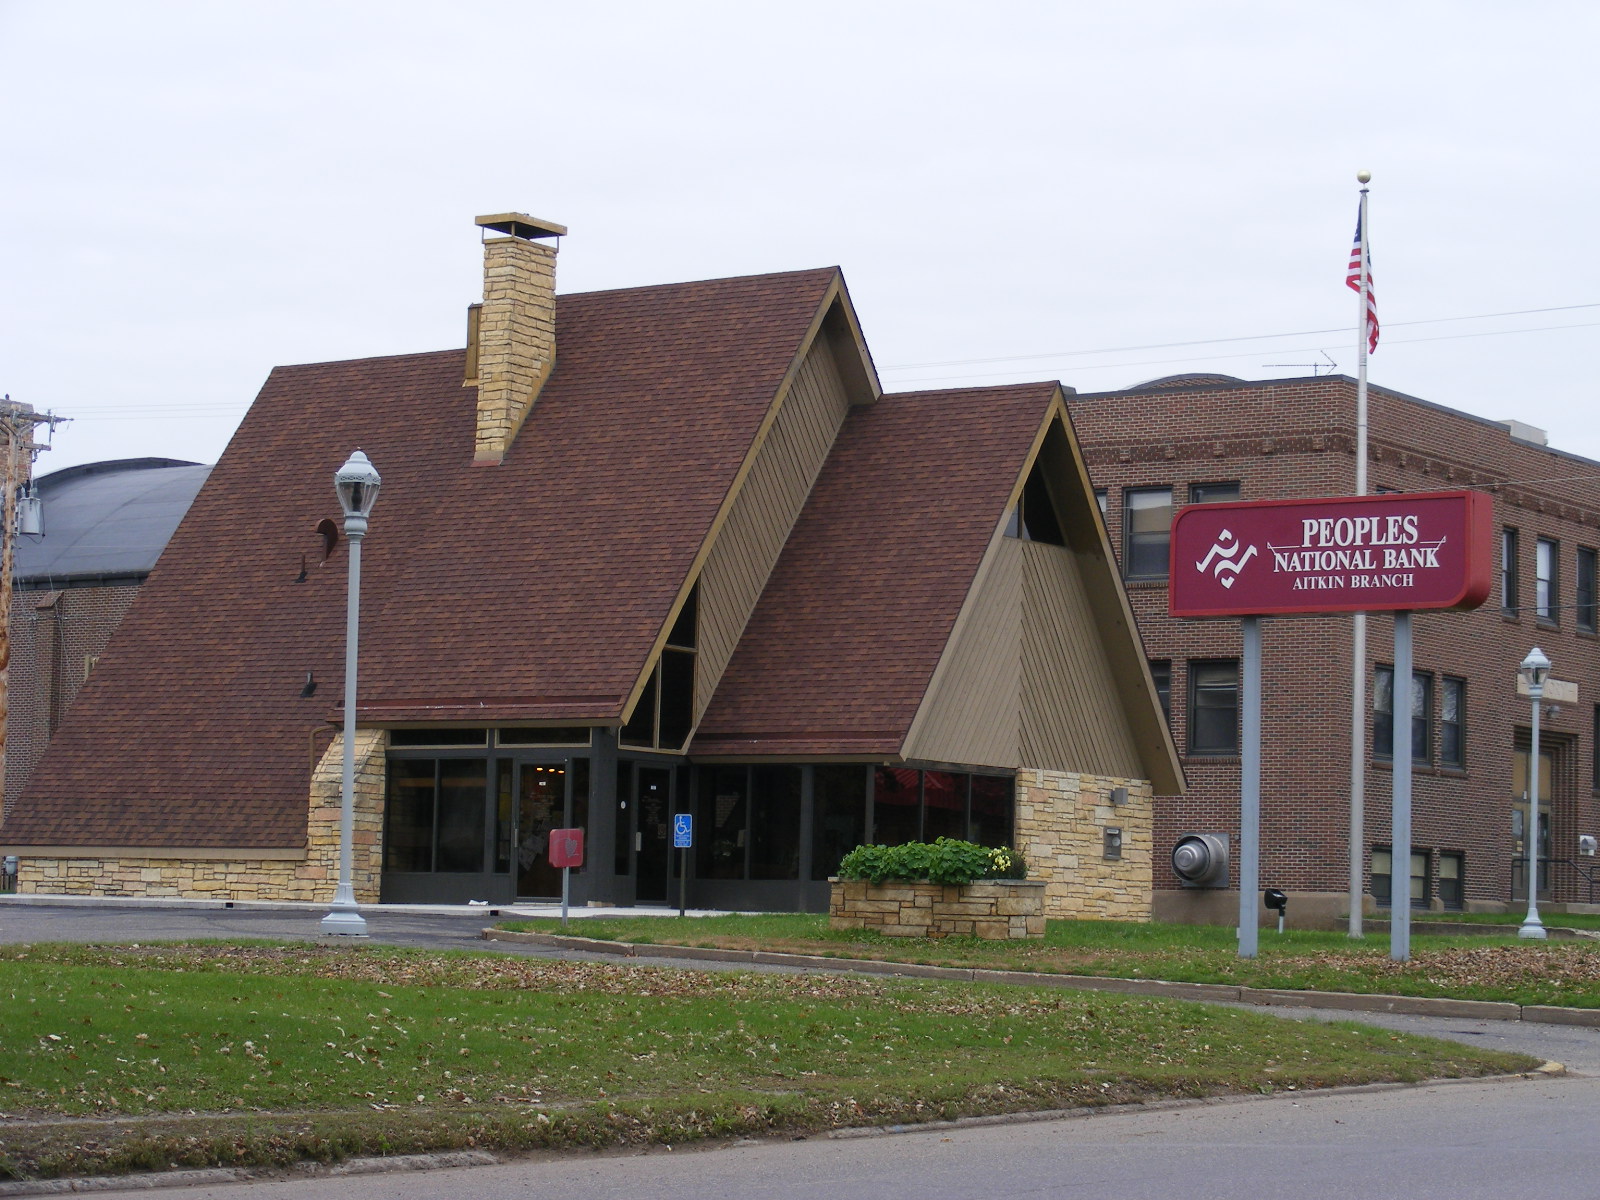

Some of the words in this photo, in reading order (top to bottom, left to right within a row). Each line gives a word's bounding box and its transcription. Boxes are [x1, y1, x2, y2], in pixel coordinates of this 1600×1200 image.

[1301, 515, 1418, 548] PEOPLES
[1273, 550, 1376, 573] NATIONAL
[1382, 547, 1440, 569] BANK
[1292, 575, 1345, 590] AITKIN
[1351, 573, 1414, 588] BRANCH
